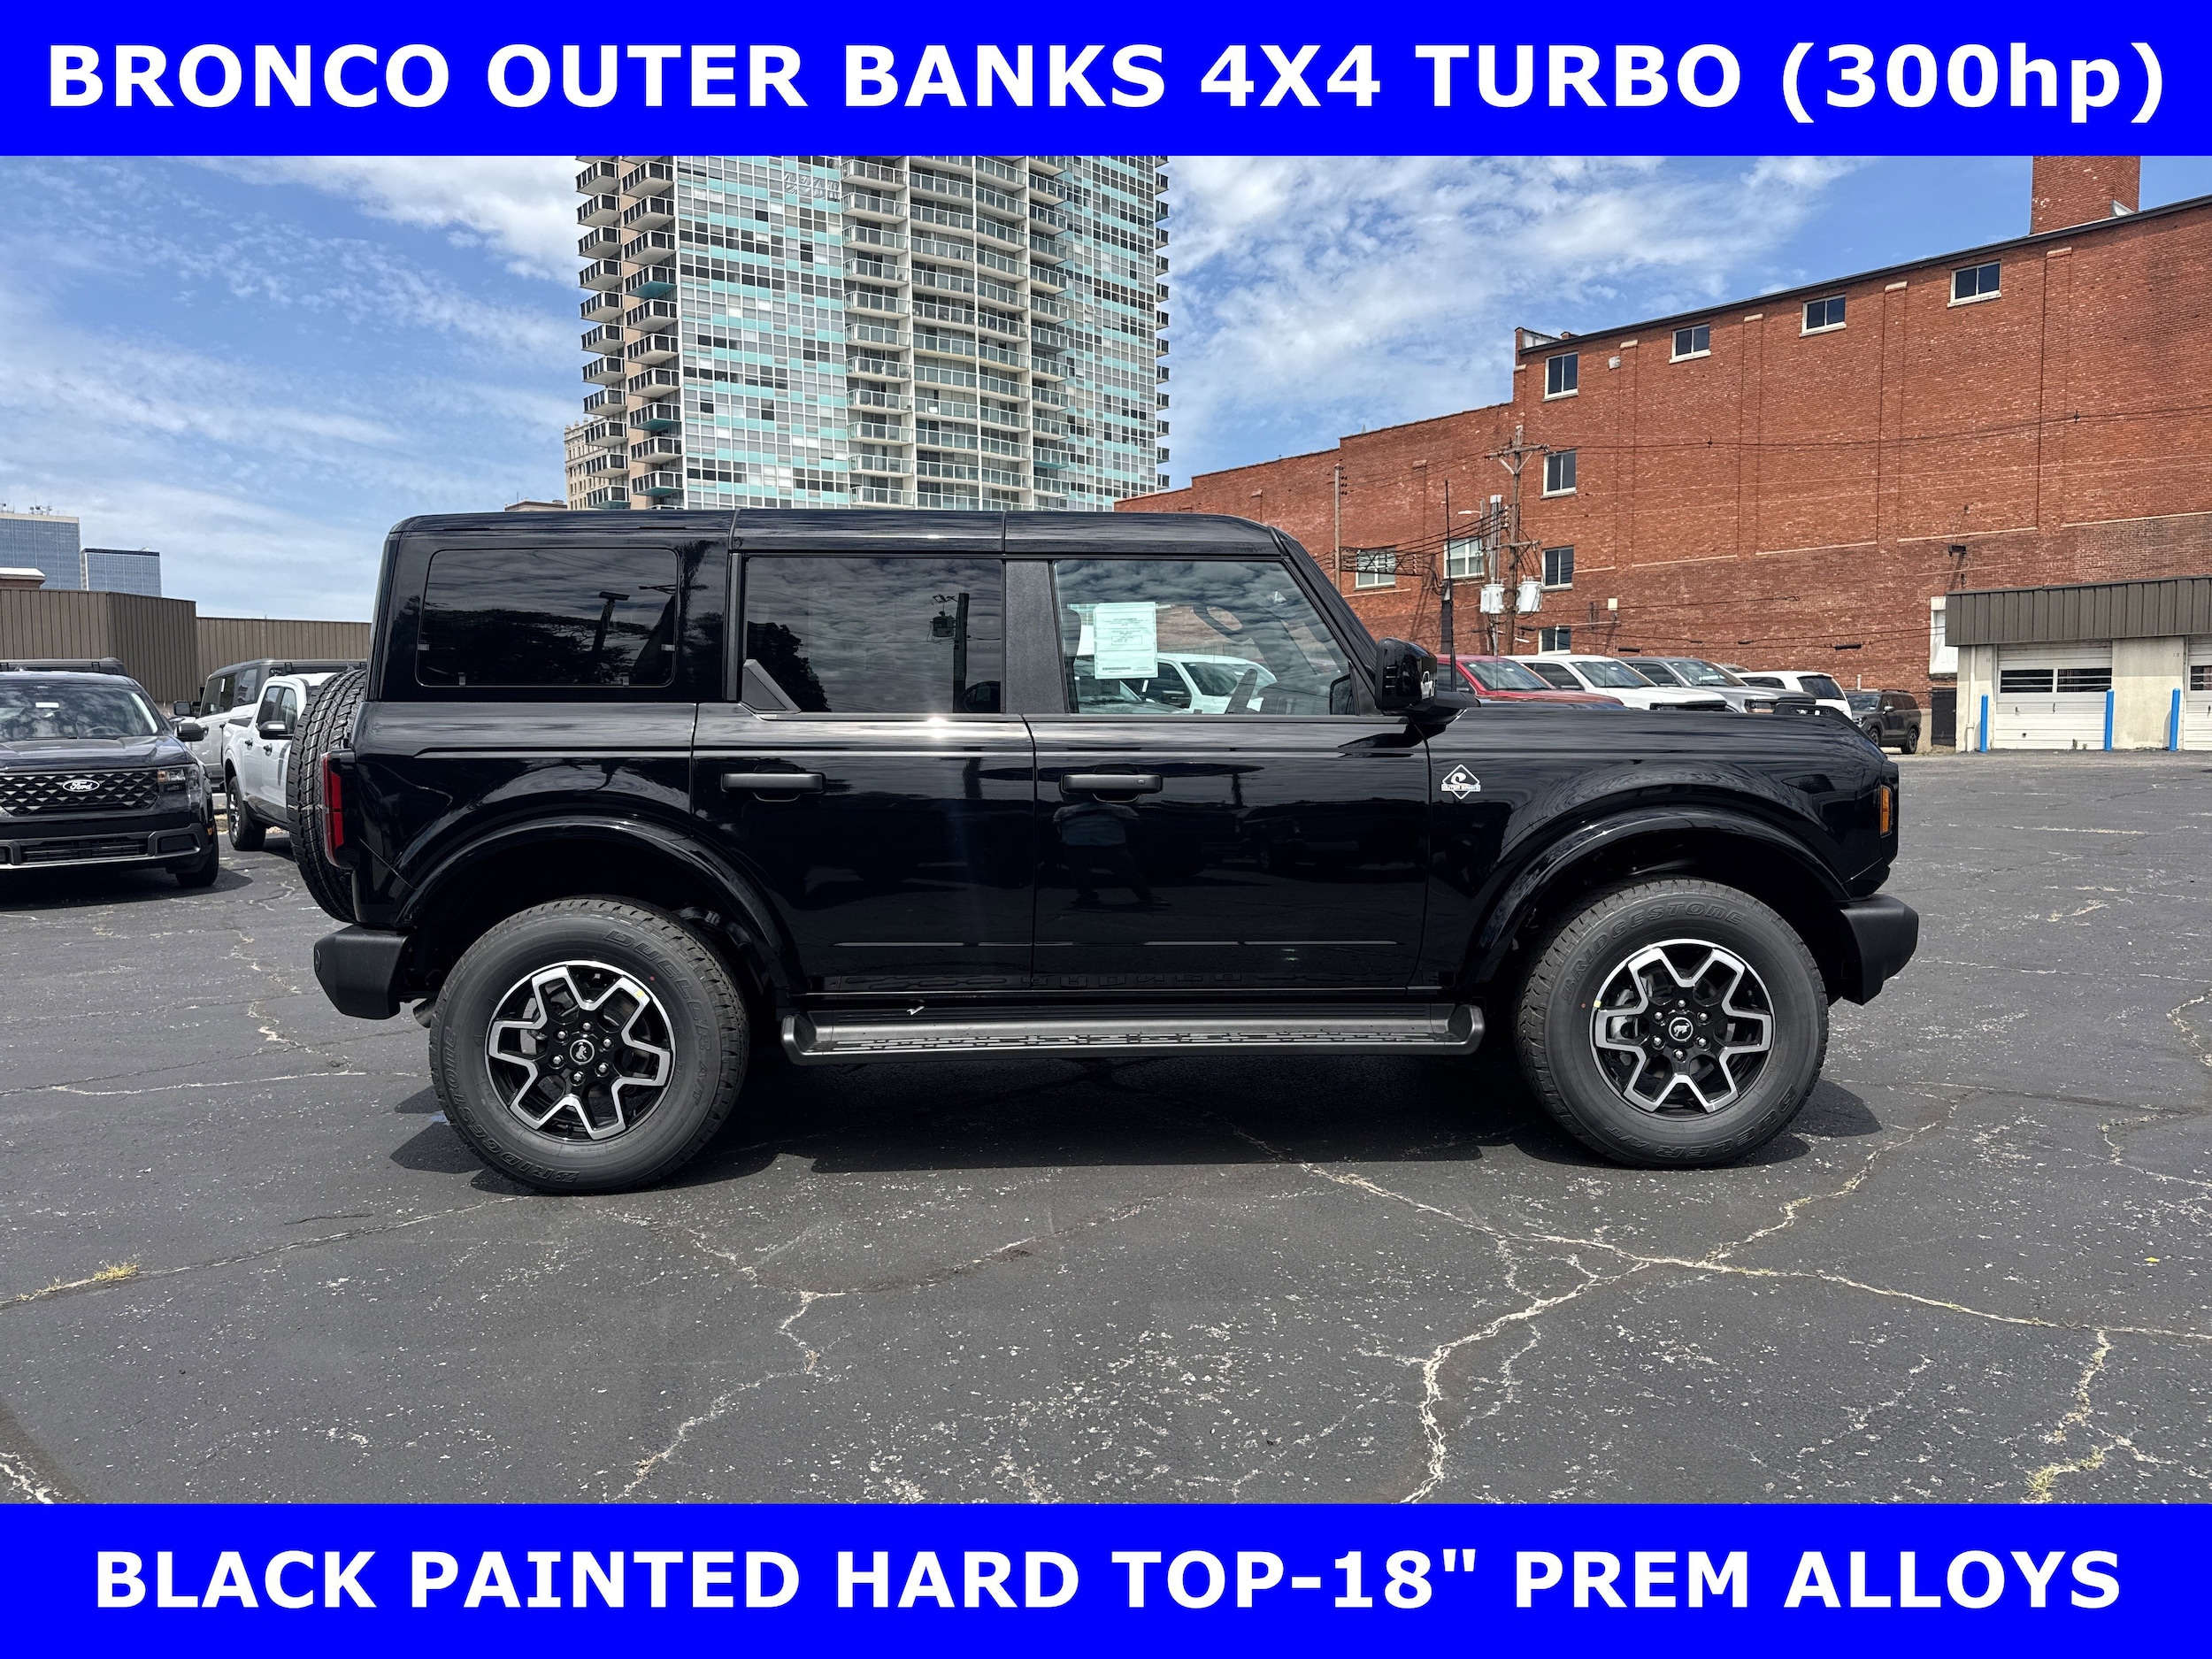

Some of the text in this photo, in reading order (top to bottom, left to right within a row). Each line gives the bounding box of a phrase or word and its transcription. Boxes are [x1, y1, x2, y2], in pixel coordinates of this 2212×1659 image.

[70, 780, 93, 790] Ford
[1559, 901, 1747, 1004] BRIDGESTONE
[603, 930, 711, 1106] DUELER A/T
[444, 1025, 580, 1183] BRIDGESTONE
[1605, 1083, 1798, 1160] DUELER A/T
